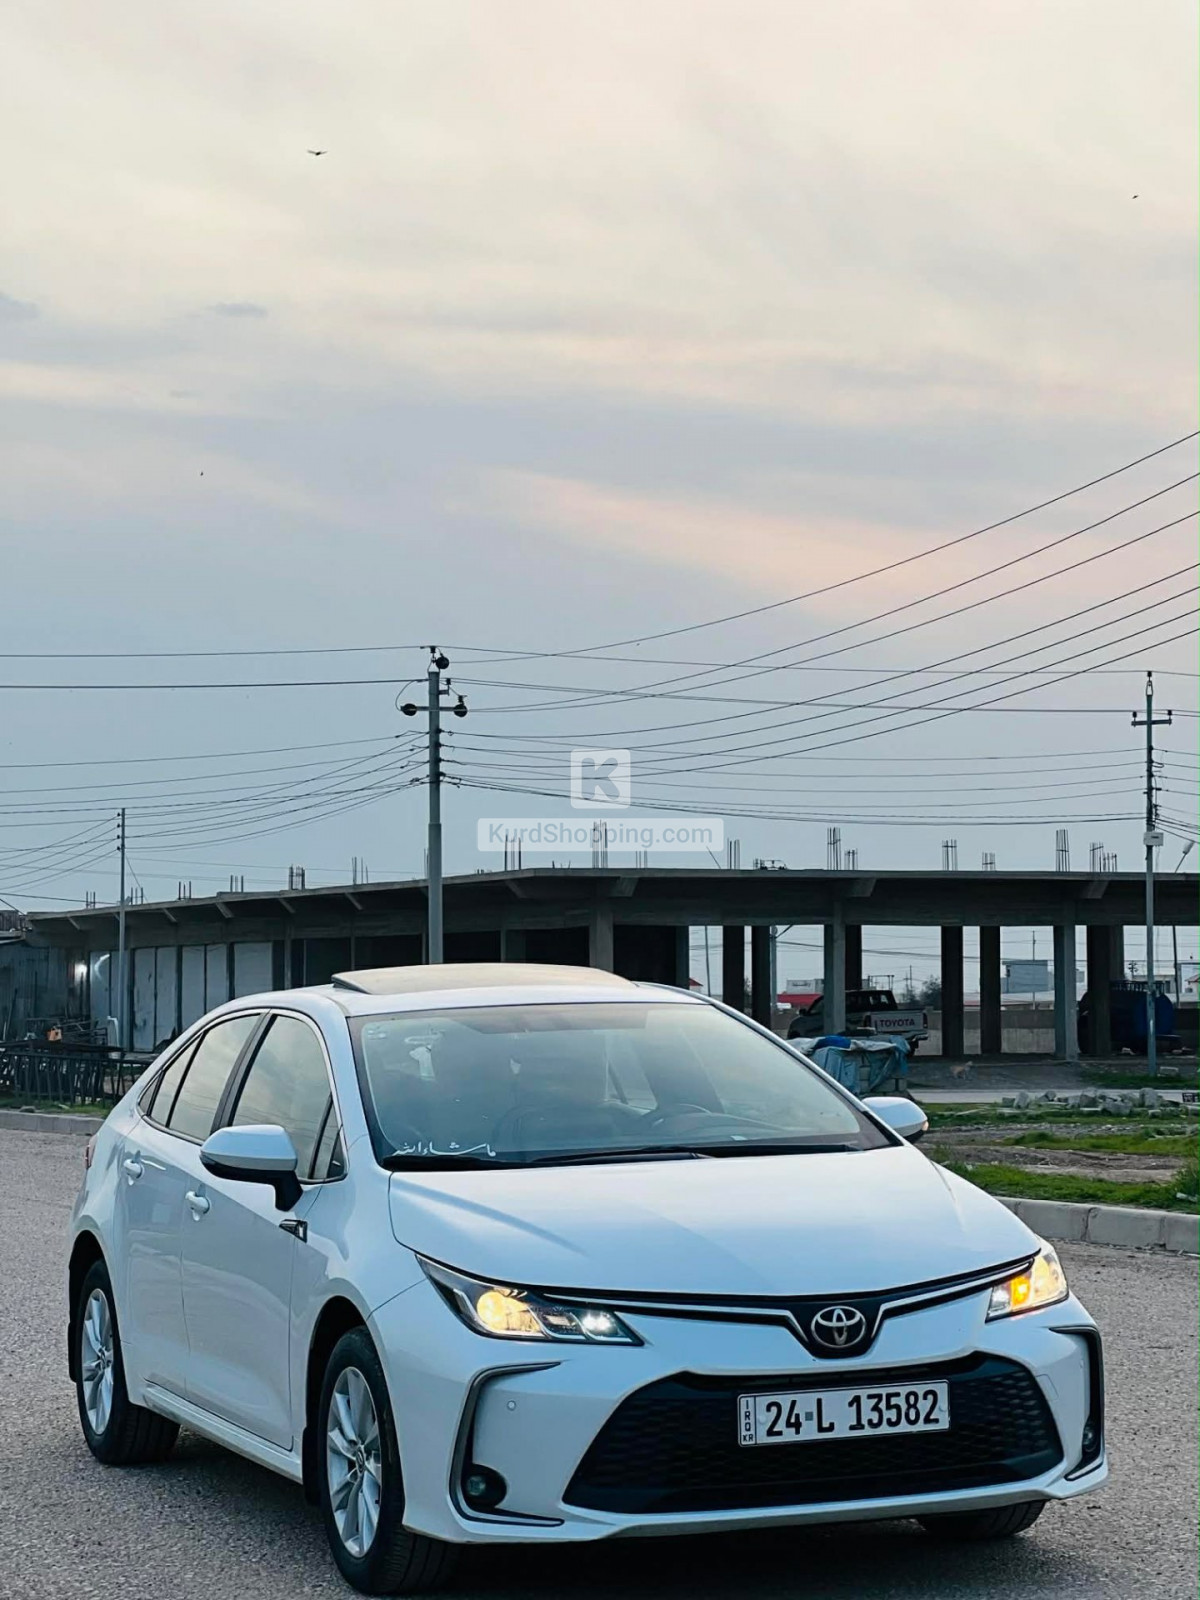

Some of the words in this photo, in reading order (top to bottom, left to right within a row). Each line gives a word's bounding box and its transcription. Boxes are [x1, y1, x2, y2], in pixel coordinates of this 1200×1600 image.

[880, 1019, 915, 1027] TOYOTA
[847, 1389, 940, 1431] 13582
[742, 1433, 754, 1443] KR
